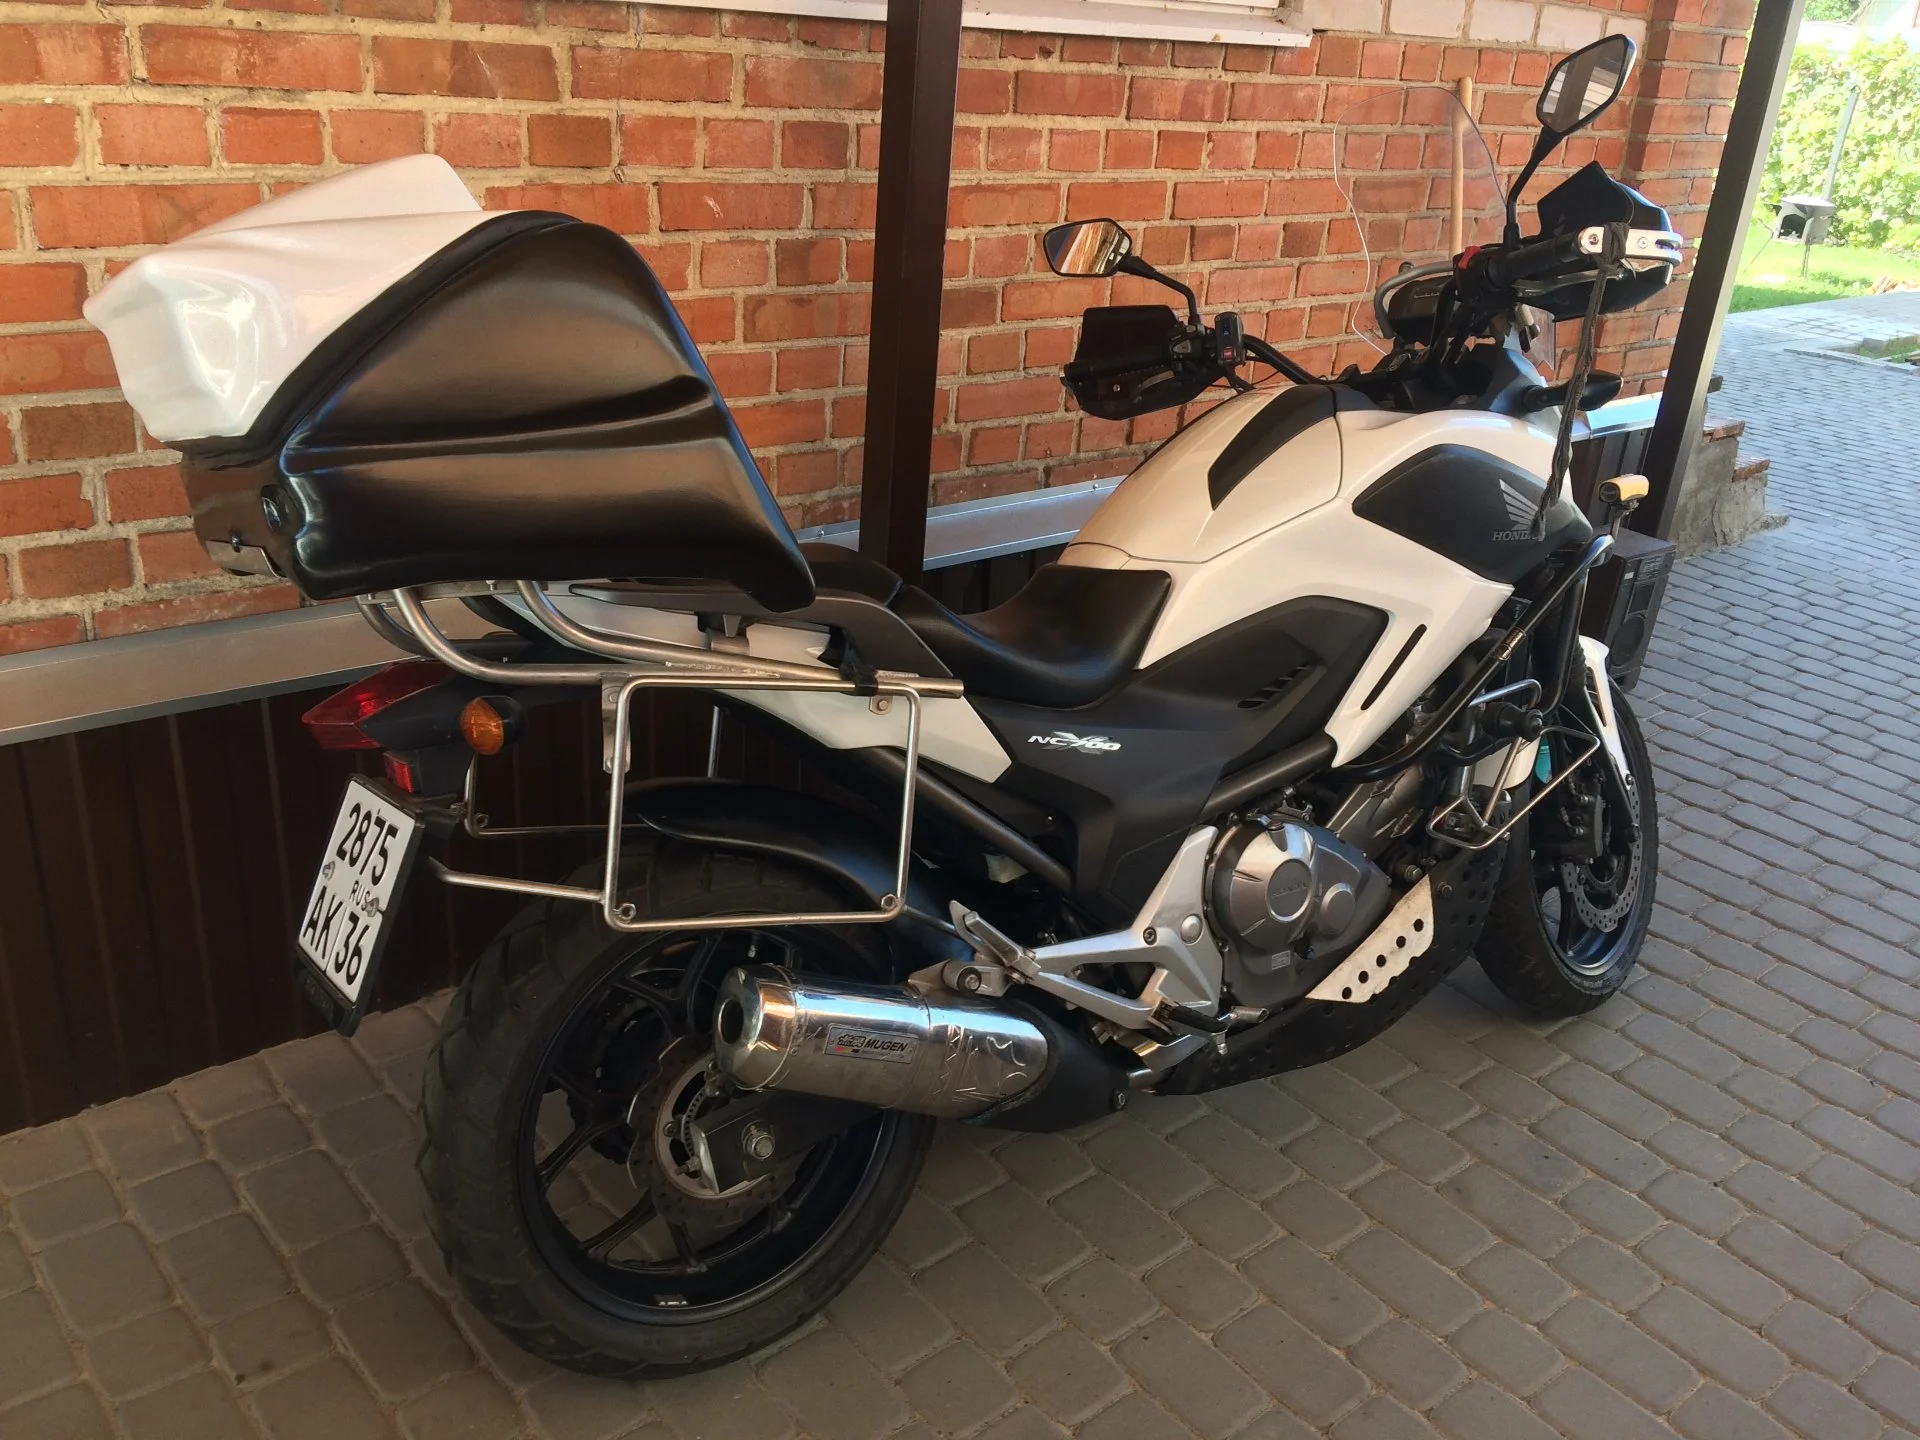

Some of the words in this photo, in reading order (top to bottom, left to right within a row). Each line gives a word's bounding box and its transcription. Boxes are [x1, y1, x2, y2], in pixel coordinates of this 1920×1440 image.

[1491, 530, 1536, 541] HOND
[336, 803, 399, 887] 2875
[349, 879, 373, 912] RUS
[302, 885, 343, 960] AK
[333, 910, 370, 986] 36
[863, 1038, 908, 1053] MUGEN
